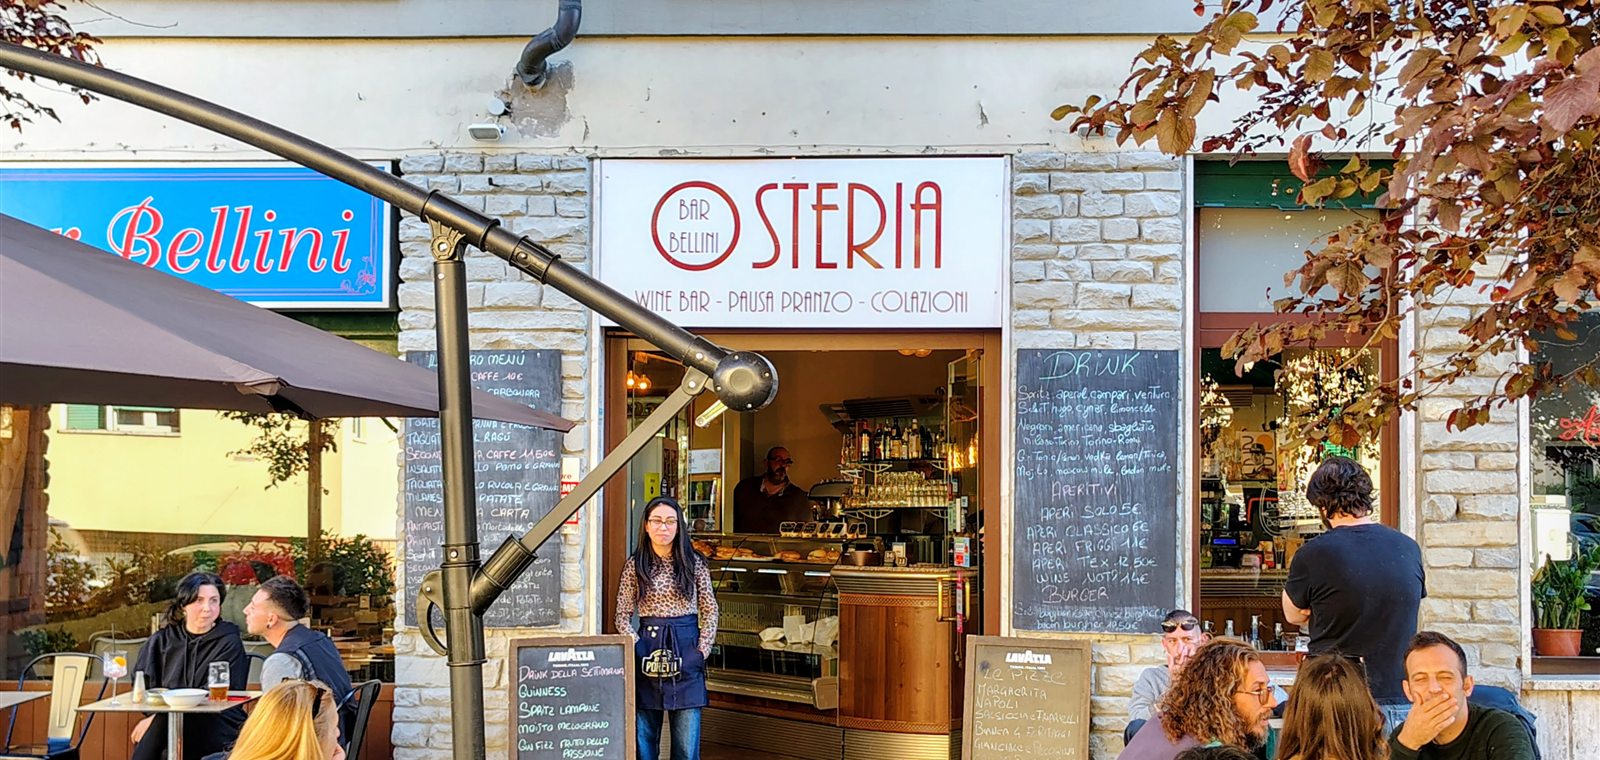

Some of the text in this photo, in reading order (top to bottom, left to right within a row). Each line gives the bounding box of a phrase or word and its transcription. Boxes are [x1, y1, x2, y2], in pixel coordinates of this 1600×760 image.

[679, 199, 710, 221] BAR
[107, 196, 354, 274] Bellini
[669, 231, 719, 254] BELLINI
[635, 290, 672, 313] WINE
[679, 291, 710, 313] BAR
[729, 291, 774, 313] PAUSA
[781, 291, 853, 313] PRANZO
[871, 291, 968, 313] COLAZIONI
[491, 508, 530, 519] CARTA
[1041, 585, 1109, 604] BURGER
